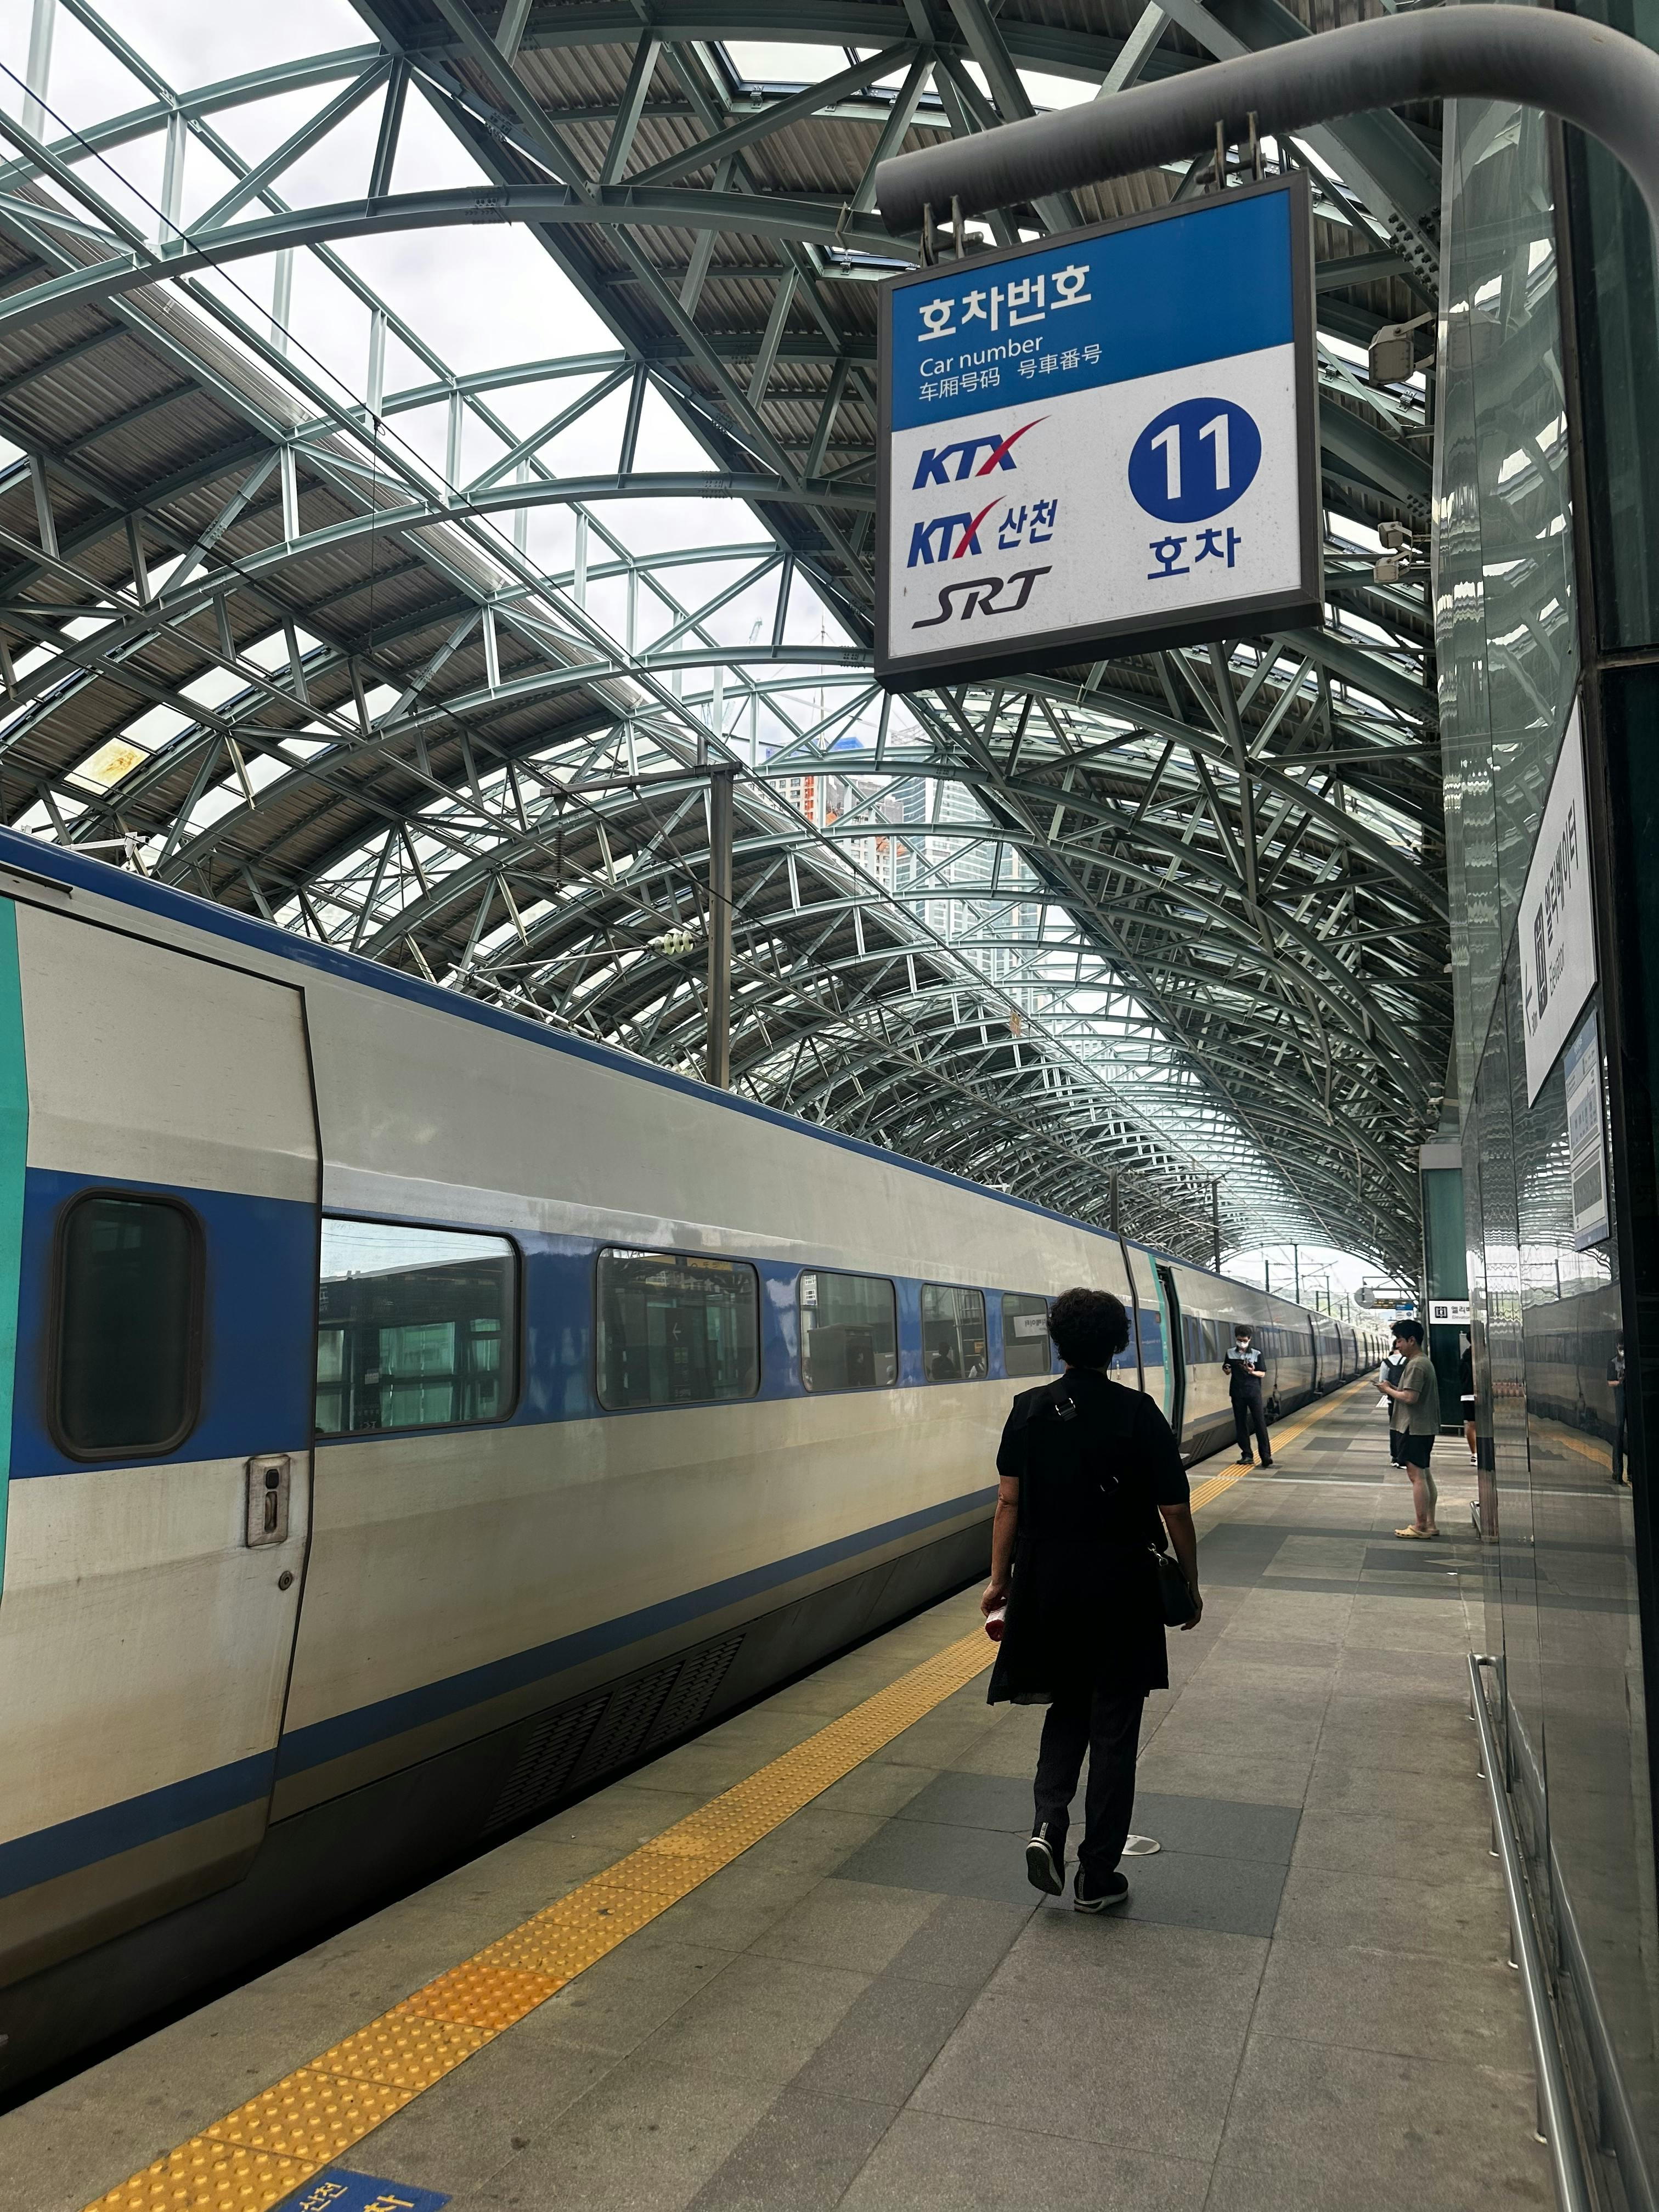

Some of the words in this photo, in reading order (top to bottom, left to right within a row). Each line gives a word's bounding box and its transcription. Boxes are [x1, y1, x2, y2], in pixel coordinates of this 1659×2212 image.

[918, 264, 1092, 342] 호차번호
[918, 366, 1000, 402] 车厢号码
[1017, 343, 1103, 379] 号車番号
[919, 357, 954, 377] Car
[960, 336, 1043, 369] number
[912, 415, 1052, 490] KTX
[1151, 413, 1231, 500] 11
[907, 495, 1008, 568] KTX
[998, 499, 1058, 550] 산천
[1147, 527, 1242, 580] 호차
[911, 565, 1053, 629] SRT
[1545, 798, 1578, 948] 엘리베이터
[1549, 941, 1565, 997] Elevator
